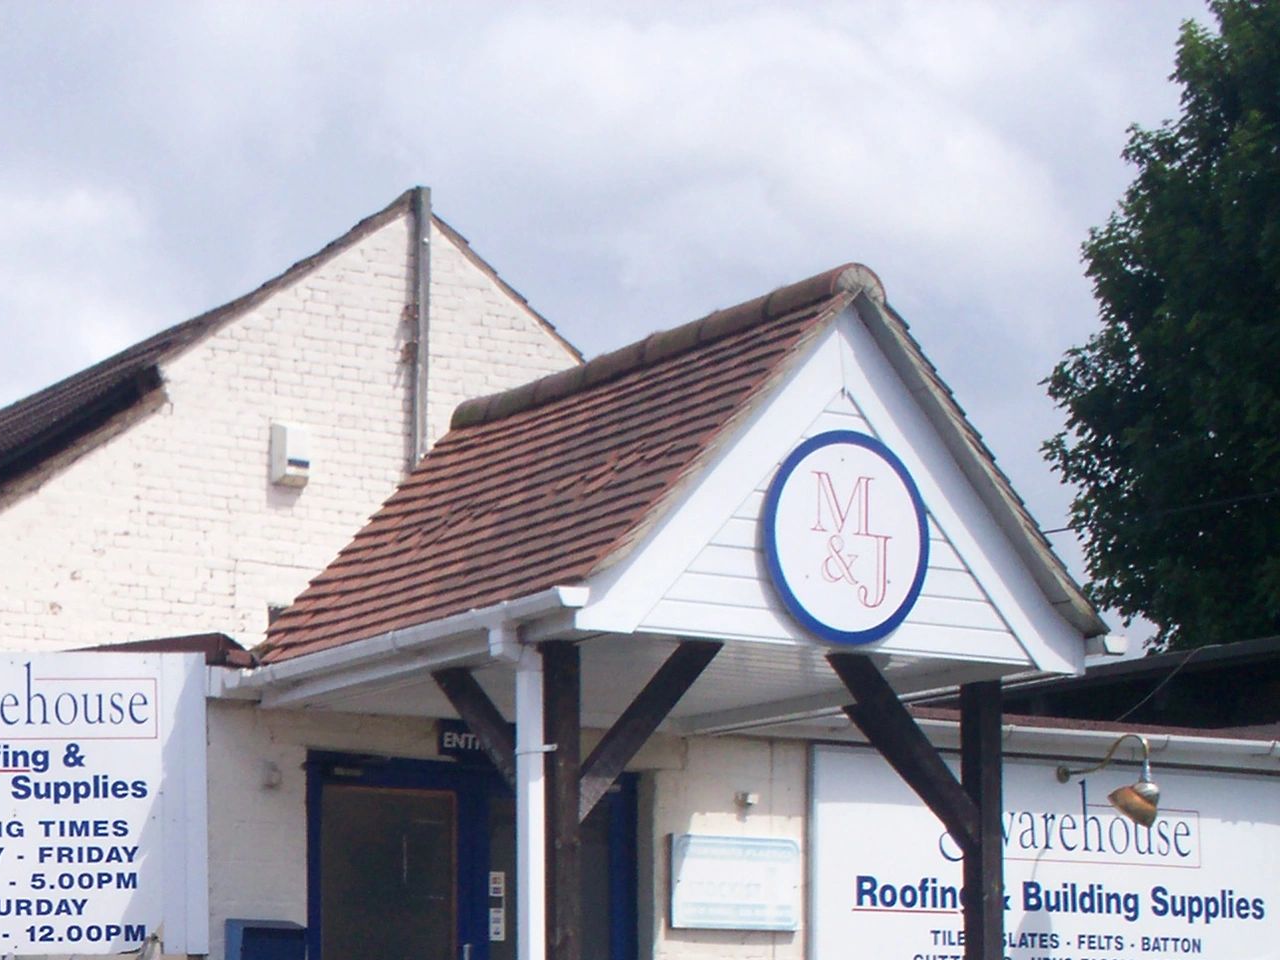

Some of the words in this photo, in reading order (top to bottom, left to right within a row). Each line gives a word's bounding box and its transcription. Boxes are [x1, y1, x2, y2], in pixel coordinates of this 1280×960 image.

[62, 743, 86, 768] &
[10, 774, 149, 804] Supplies
[38, 819, 130, 838] TIMES
[38, 845, 140, 864] FRIDAY
[30, 871, 139, 890] 5.00PM
[855, 875, 965, 913] Roofin
[1022, 880, 1140, 921] Building
[1150, 886, 1266, 924] Supplies
[25, 923, 147, 943] 12.00PM
[930, 929, 966, 947] TILE
[1077, 934, 1124, 952] FELTS
[1141, 936, 1202, 954] BATTON
